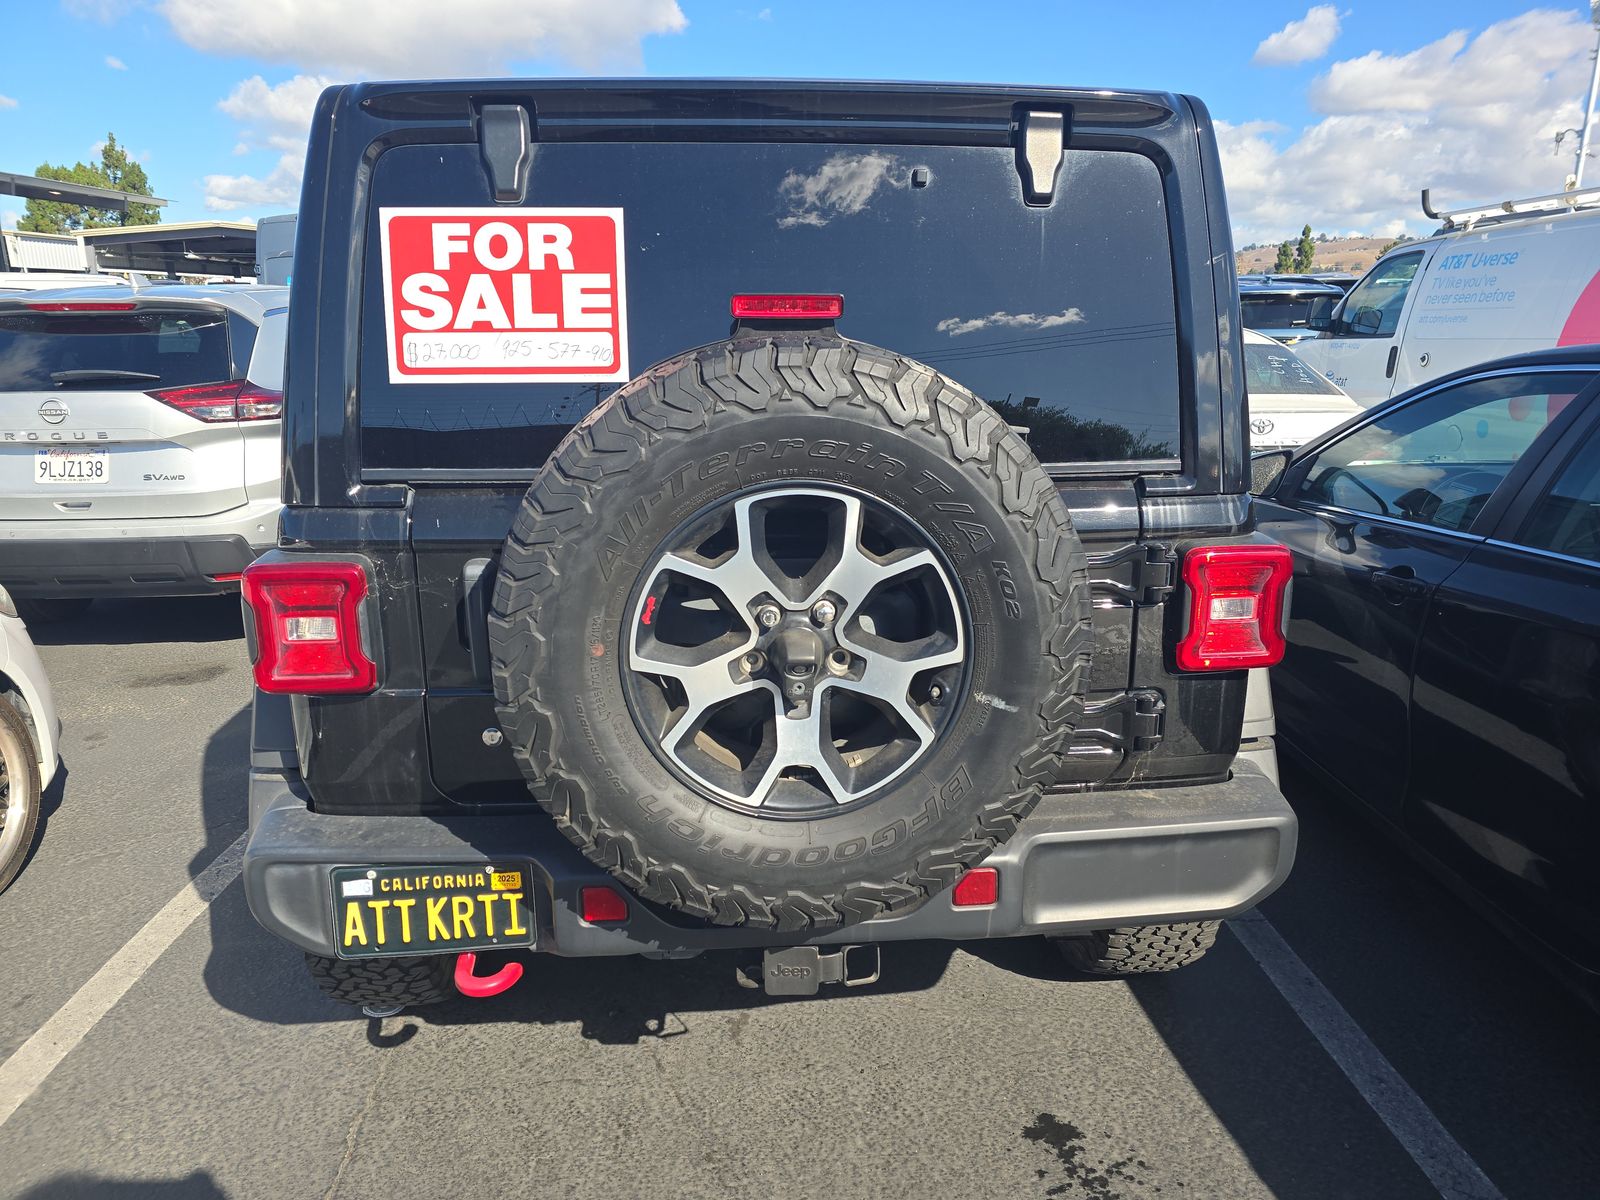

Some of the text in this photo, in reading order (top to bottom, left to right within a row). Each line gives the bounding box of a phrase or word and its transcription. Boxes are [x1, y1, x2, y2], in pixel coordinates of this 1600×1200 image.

[432, 221, 575, 271] FOR
[1439, 251, 1519, 270] AT&T U-verse
[1432, 274, 1497, 291] TV like you've
[400, 272, 613, 331] SALE
[1424, 288, 1516, 305] never seen before
[38, 408, 69, 416] NISSAN
[4, 431, 109, 441] ROGUE
[39, 460, 104, 478] 9LJZ138
[143, 473, 163, 481] SV
[596, 438, 907, 582] All-Terrain
[575, 694, 606, 765] Champion
[637, 763, 974, 867] BFGoodrich
[380, 873, 486, 892] CALIFORNIA
[497, 874, 516, 883] 2025
[344, 893, 527, 947] ATT KRTI
[770, 964, 811, 979] Jeep
